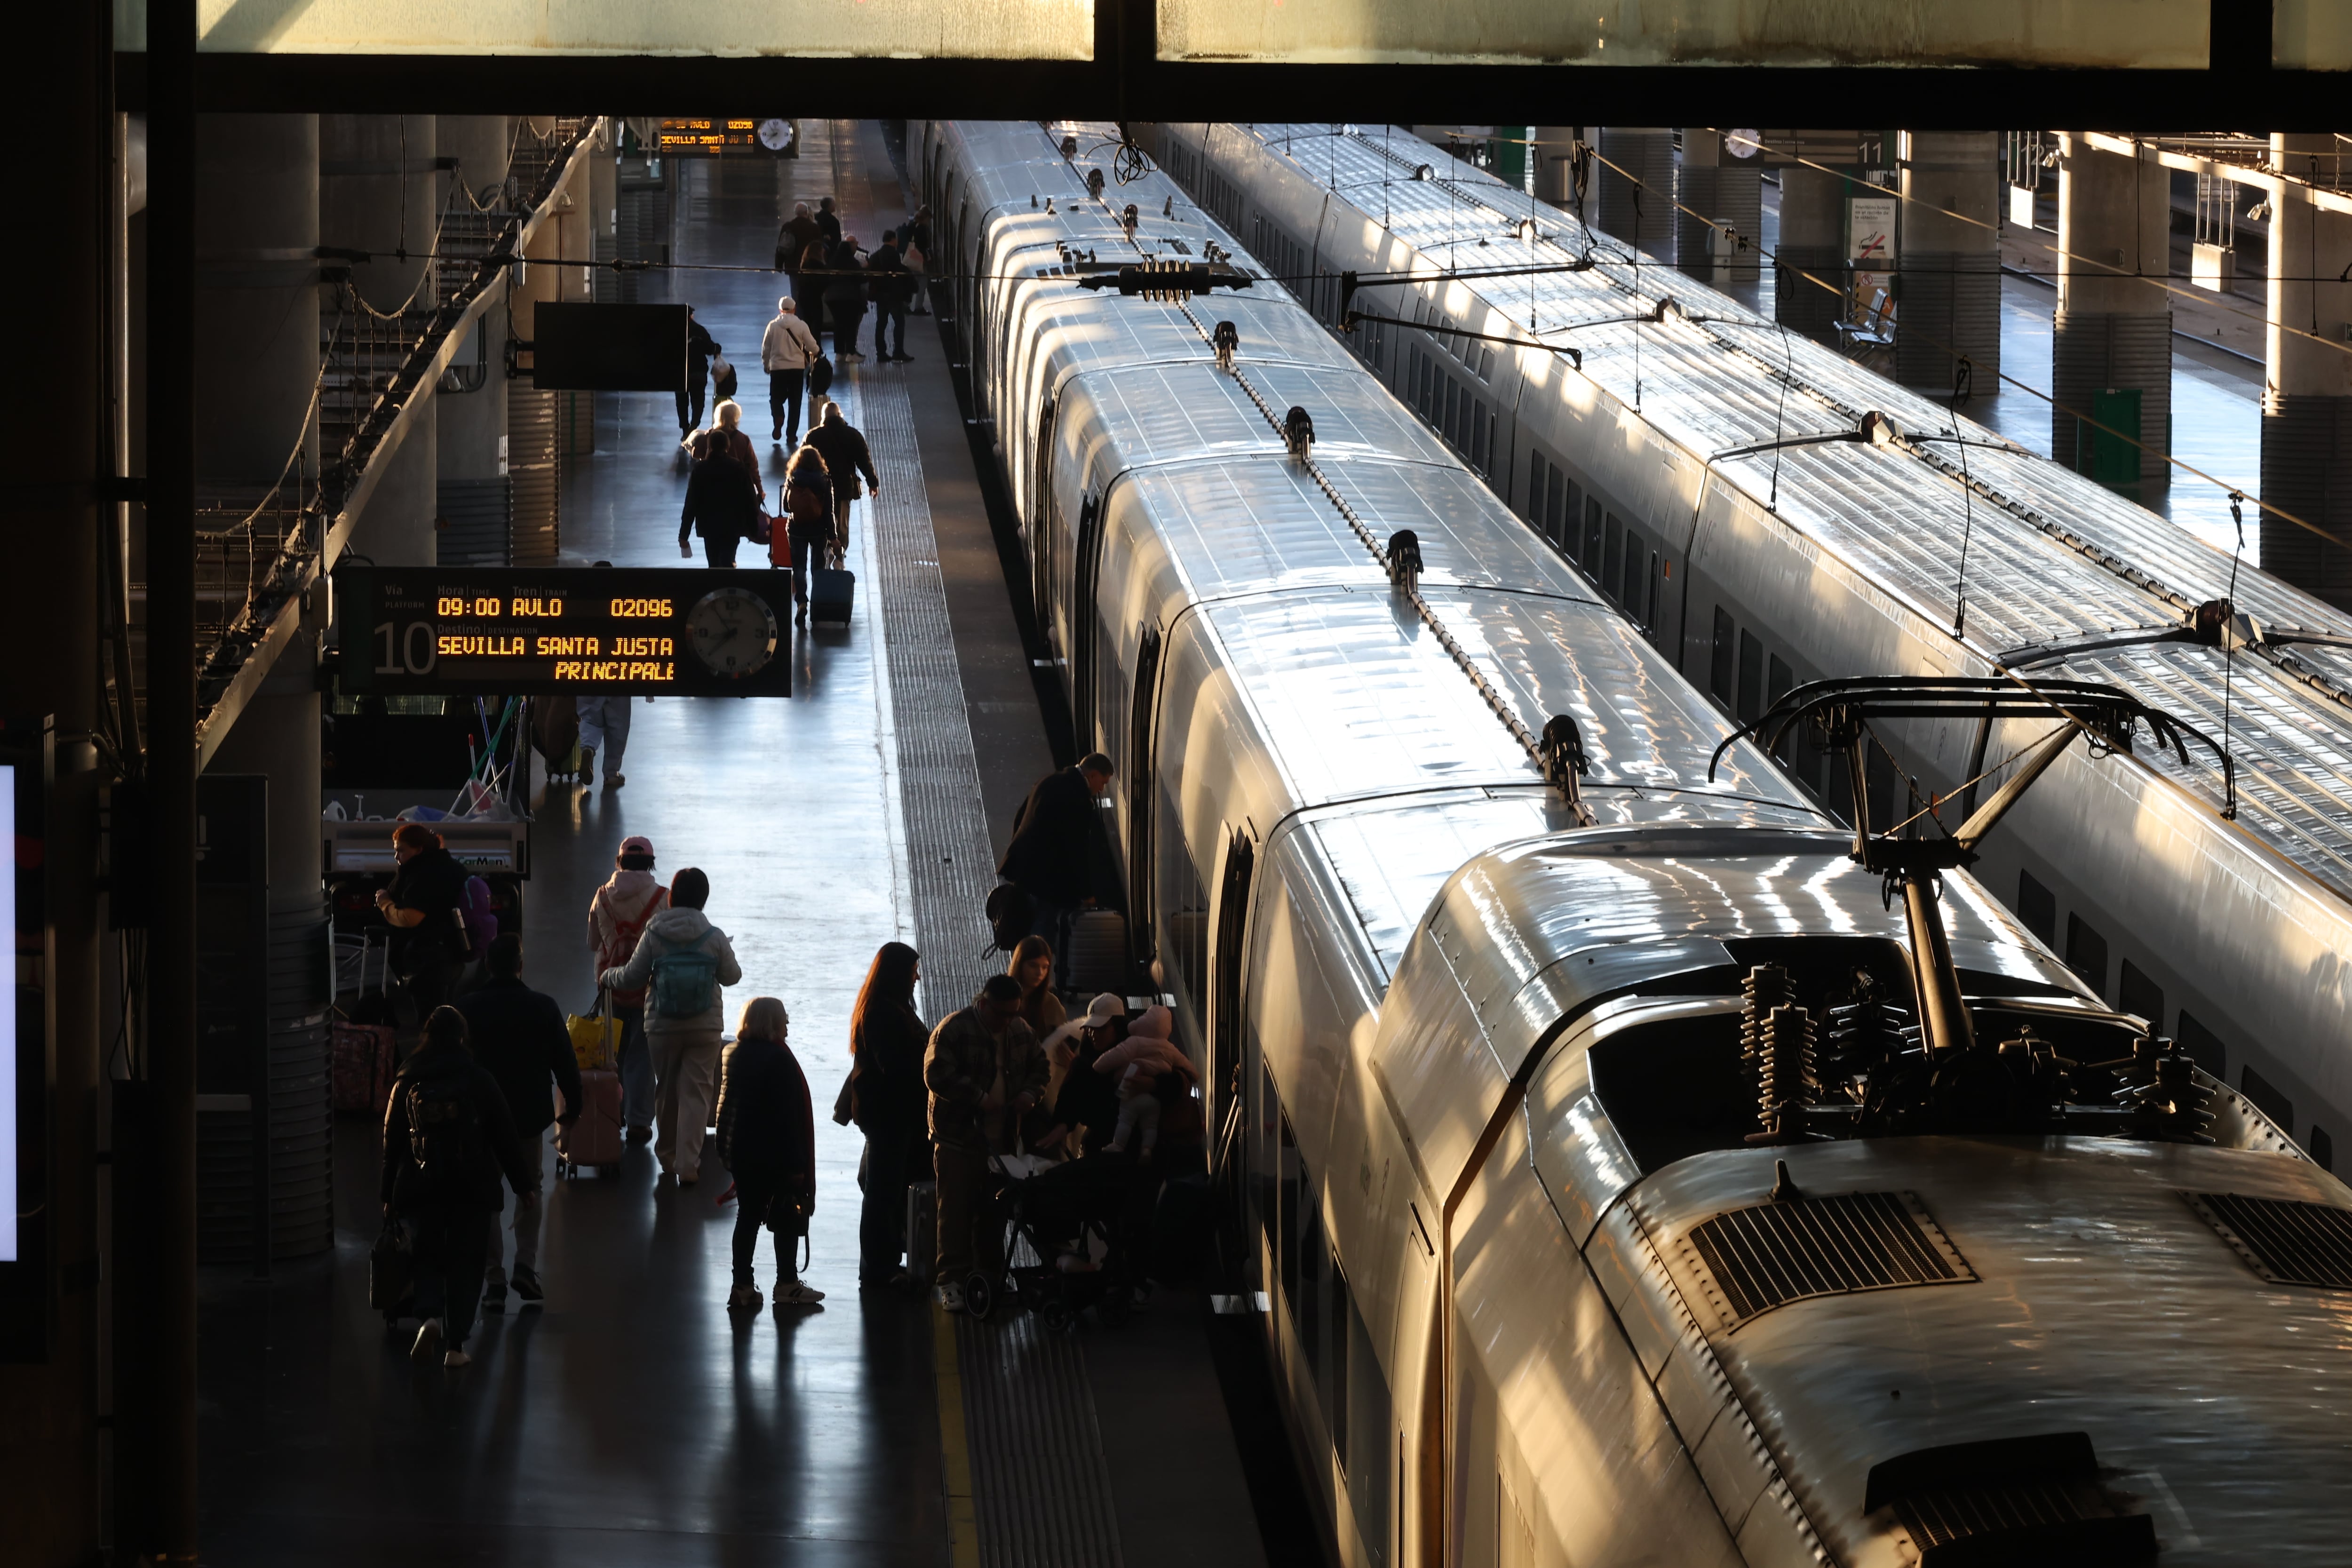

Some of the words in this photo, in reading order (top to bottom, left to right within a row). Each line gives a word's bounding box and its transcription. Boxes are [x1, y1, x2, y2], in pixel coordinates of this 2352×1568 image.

[728, 120, 753, 129] 02096
[661, 135, 696, 144] SEVILLA
[1859, 142, 1882, 164] 11
[2021, 143, 2045, 166] 12
[385, 584, 403, 595] Vía
[437, 585, 464, 596] Hora
[512, 586, 537, 596] Tren
[438, 597, 500, 616] 09:00
[512, 598, 562, 617] AVLO
[611, 598, 673, 617] 02096
[437, 623, 481, 635] Destino
[374, 621, 437, 675] 10
[438, 636, 524, 655] SEVILLA
[537, 637, 599, 655] SANTA
[611, 637, 673, 656] JUSTA
